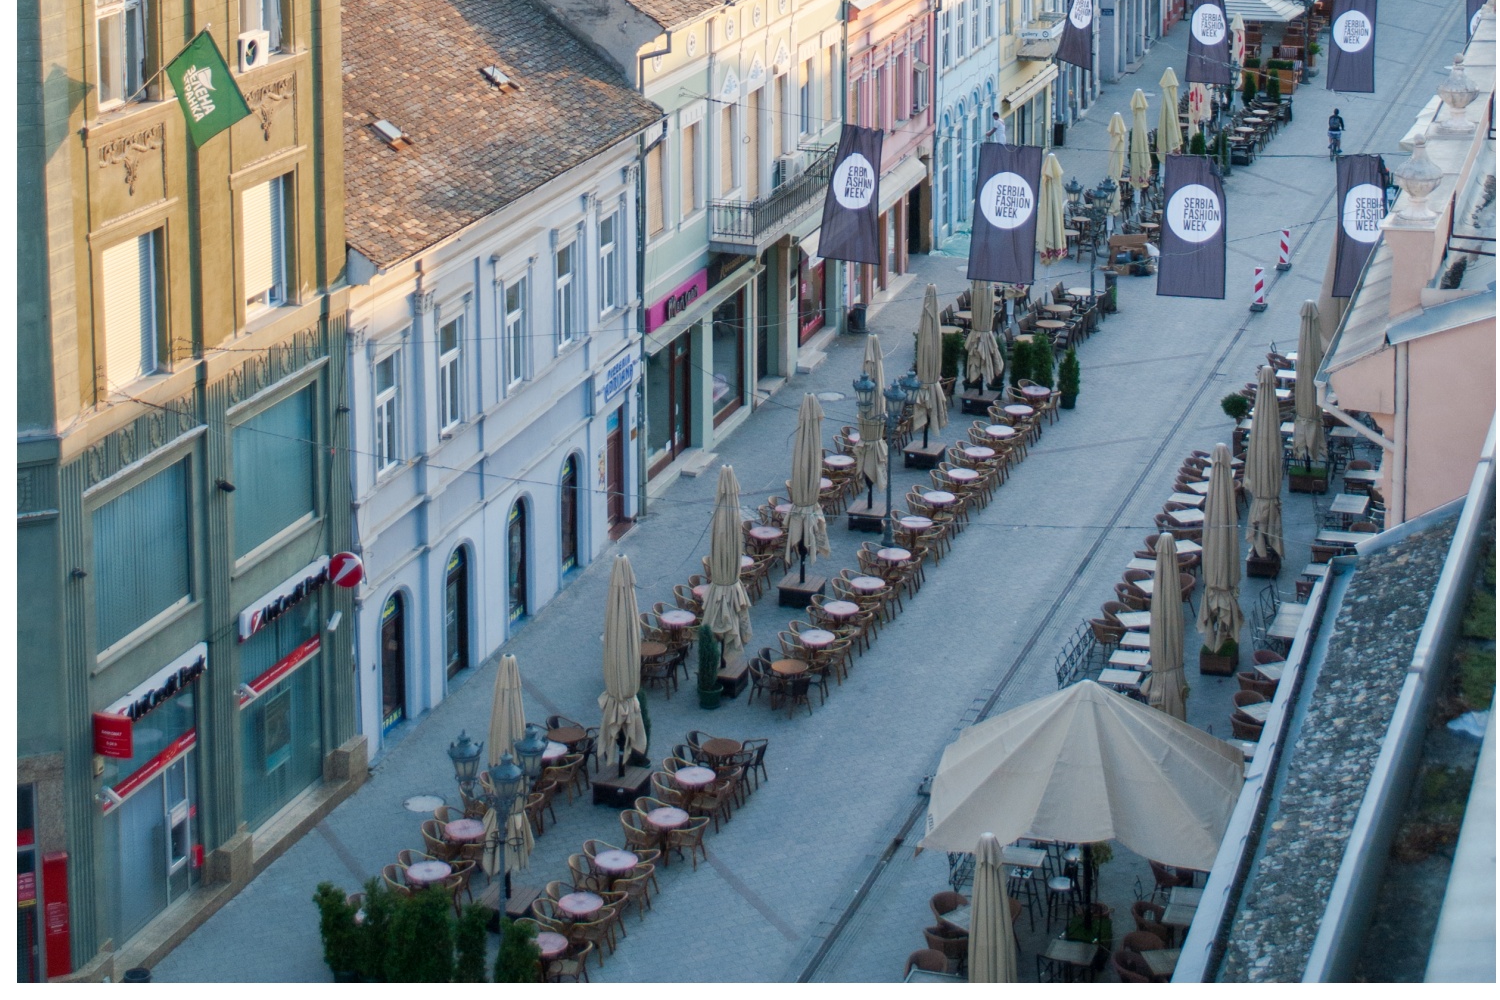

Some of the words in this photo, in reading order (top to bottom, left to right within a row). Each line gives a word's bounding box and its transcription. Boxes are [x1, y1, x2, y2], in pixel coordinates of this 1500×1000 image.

[1201, 13, 1222, 23] SERBIA
[1344, 20, 1365, 28] SERBIA
[1201, 21, 1224, 30] FASHION
[1343, 27, 1369, 36] FASHION
[1201, 28, 1217, 38] WEEK
[1343, 35, 1360, 44] WEEK
[186, 64, 216, 116] ЗЕЛЕНА
[844, 187, 865, 199] WEEK
[996, 184, 1025, 198] SERBIA
[995, 195, 1031, 209] FASHION
[1184, 197, 1214, 210] SERBIA
[994, 206, 1018, 219] WEEK
[1183, 208, 1220, 222] FASHION
[1355, 208, 1385, 220] FASHIO
[1183, 219, 1207, 232] WEEK
[1355, 219, 1379, 231] WEEK
